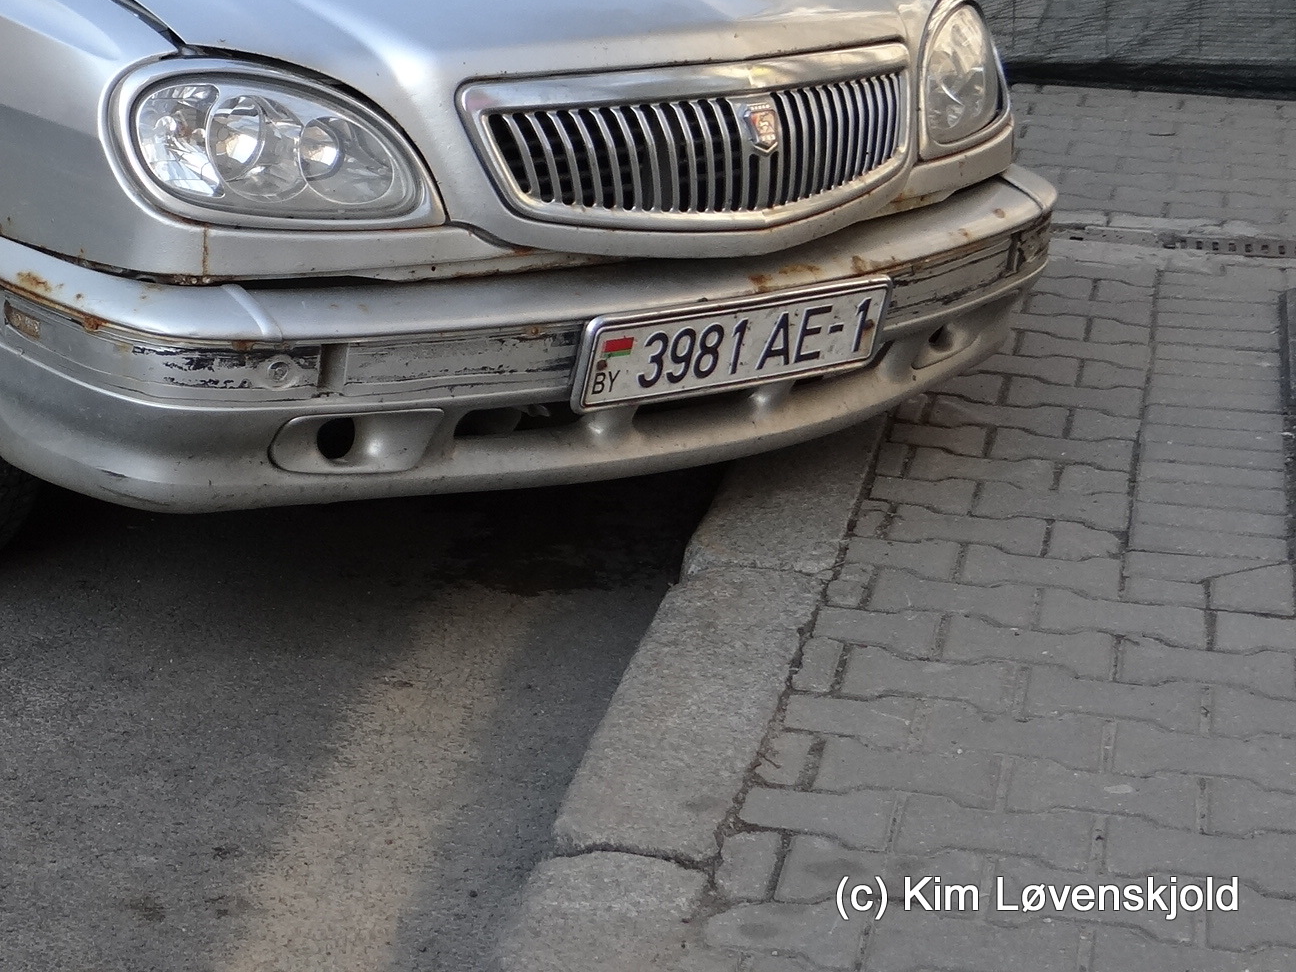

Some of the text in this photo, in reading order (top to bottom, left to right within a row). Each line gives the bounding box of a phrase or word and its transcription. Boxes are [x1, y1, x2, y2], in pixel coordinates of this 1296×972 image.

[637, 296, 873, 389] 3981 AE-1
[591, 369, 621, 395] BY
